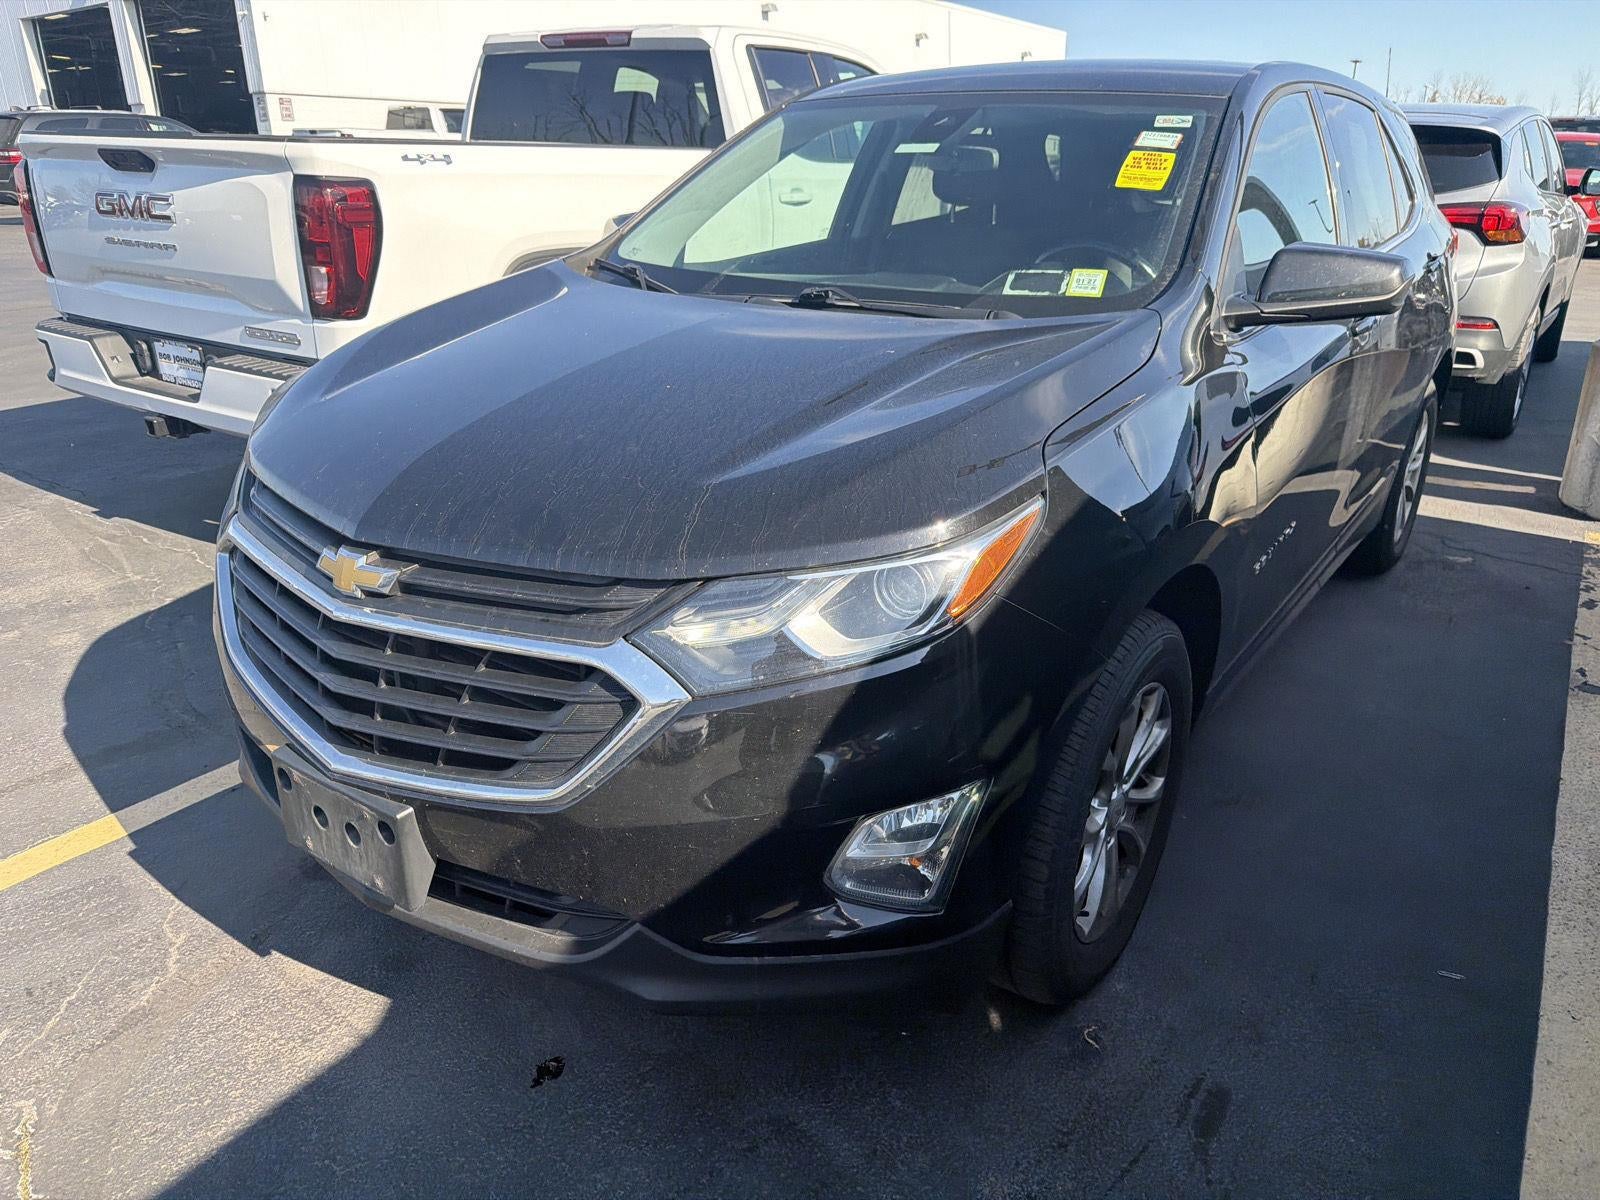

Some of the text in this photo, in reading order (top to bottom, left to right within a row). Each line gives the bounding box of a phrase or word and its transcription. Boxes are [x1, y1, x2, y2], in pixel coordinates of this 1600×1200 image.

[95, 191, 176, 224] GMC
[158, 352, 202, 368] BOB JOHNSON
[162, 374, 175, 384] BOB
